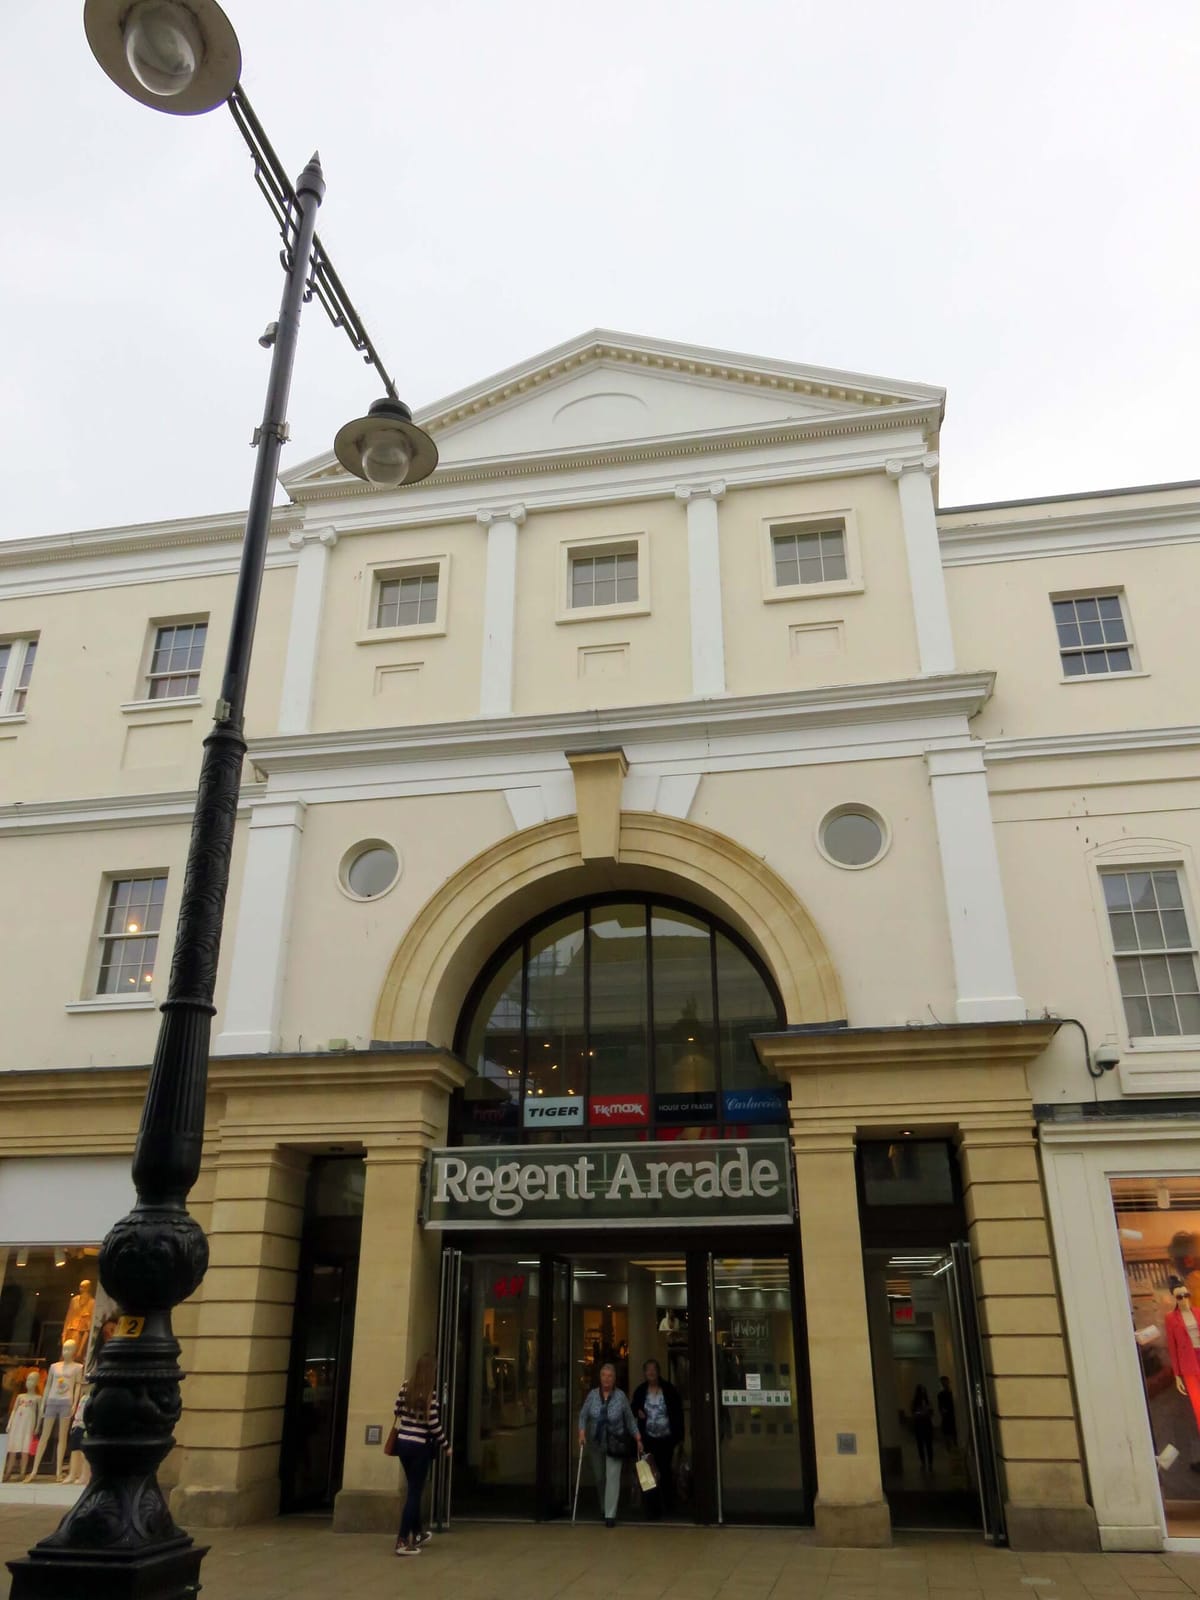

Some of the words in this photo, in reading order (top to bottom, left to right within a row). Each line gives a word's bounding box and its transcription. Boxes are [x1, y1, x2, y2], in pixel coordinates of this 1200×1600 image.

[528, 1106, 579, 1117] TIGER
[658, 1104, 679, 1112] HOUSE
[433, 1156, 595, 1216] Regent
[605, 1147, 779, 1199] Arcade
[126, 1319, 138, 1334] 2
